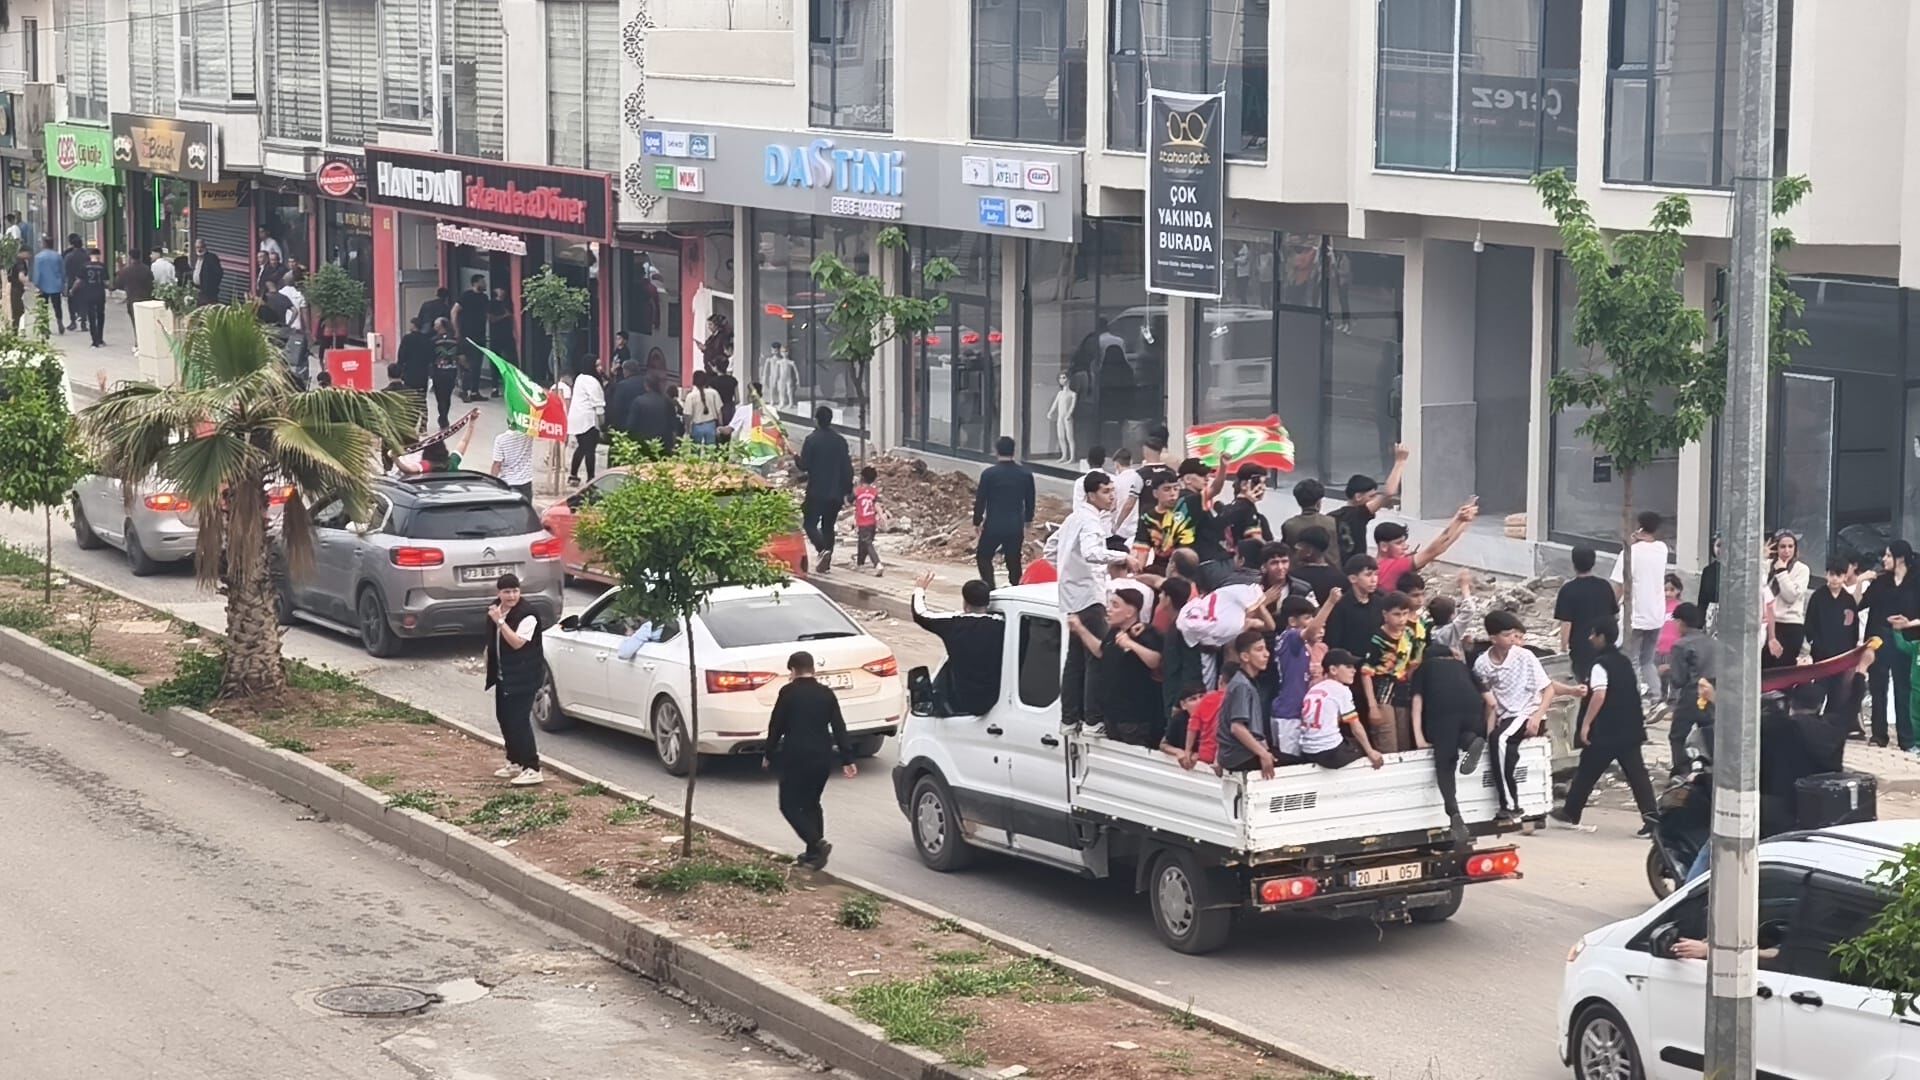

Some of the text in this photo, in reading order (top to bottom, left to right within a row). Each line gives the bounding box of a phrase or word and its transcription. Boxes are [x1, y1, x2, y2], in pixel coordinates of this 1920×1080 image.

[320, 174, 356, 186] HANEDAN
[377, 161, 462, 206] HANEDAN
[1170, 185, 1197, 207] ÇOK
[1158, 207, 1213, 228] YAKINDA
[1159, 231, 1213, 252] BURADA
[1358, 864, 1419, 886] 20 JA 057
